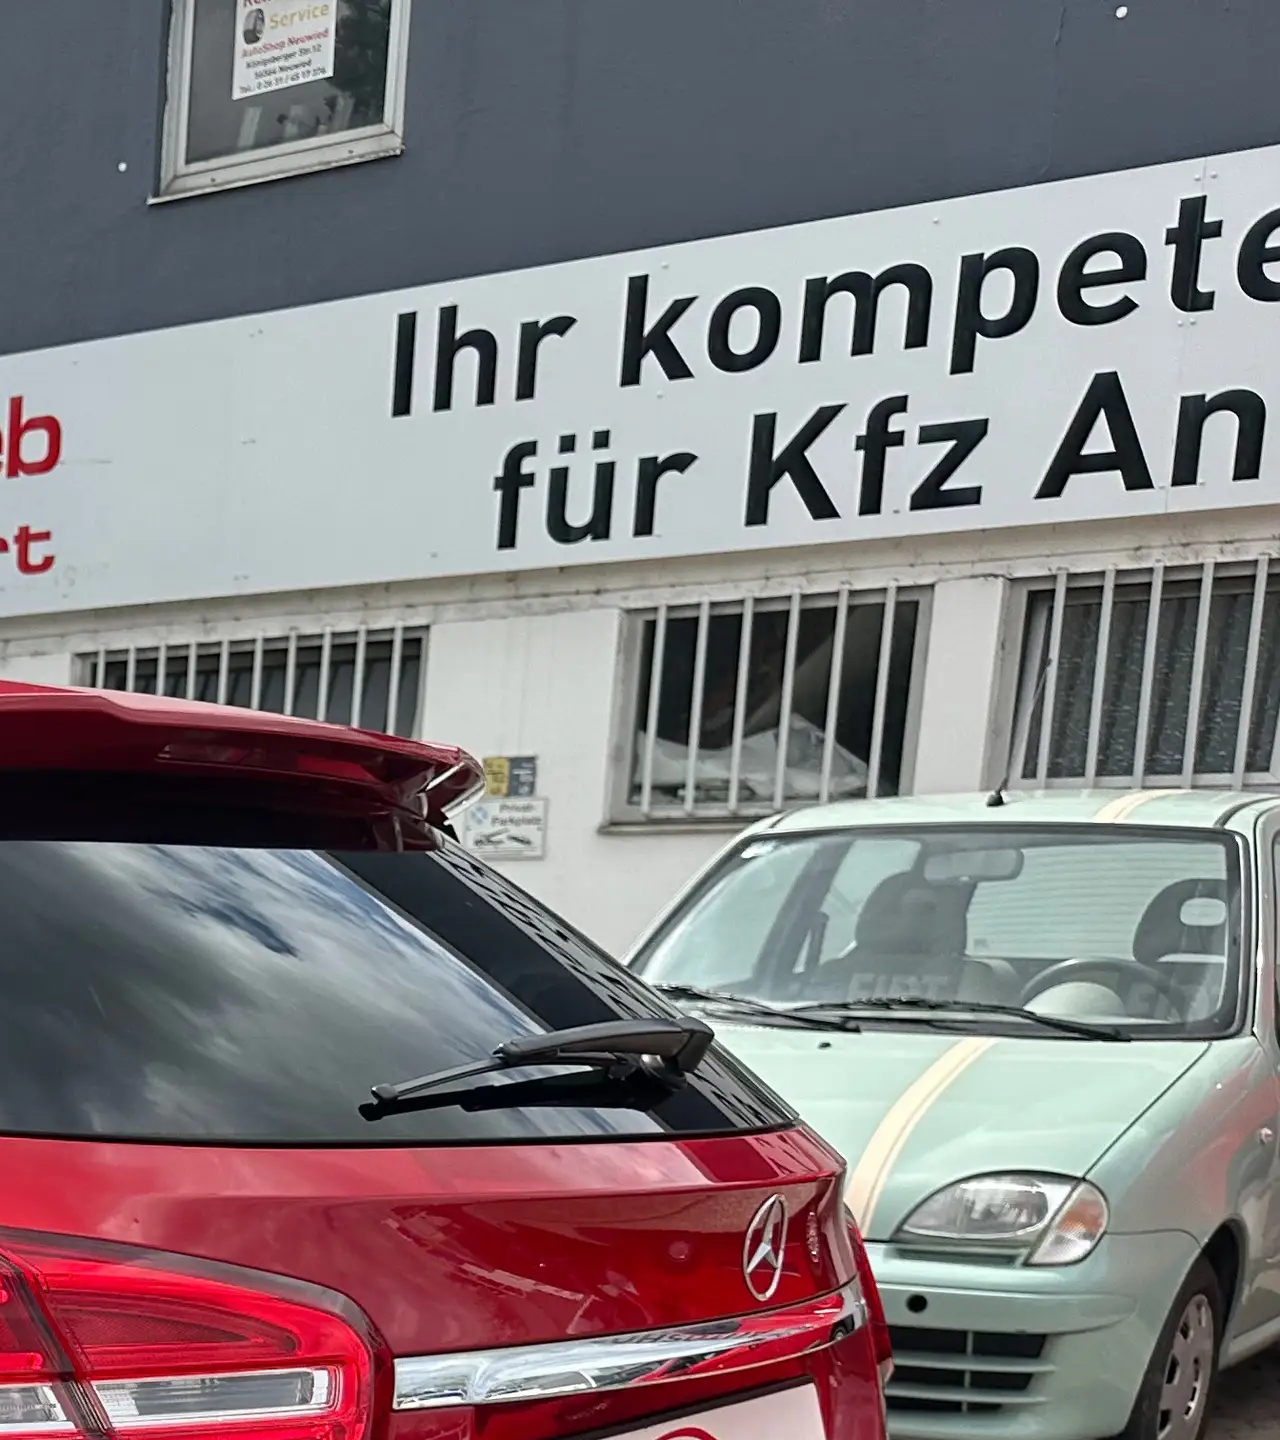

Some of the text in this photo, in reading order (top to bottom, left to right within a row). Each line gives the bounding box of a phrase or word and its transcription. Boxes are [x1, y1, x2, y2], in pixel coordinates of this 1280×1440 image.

[392, 302, 578, 418] Ihr
[493, 371, 1265, 550] für Kfz An
